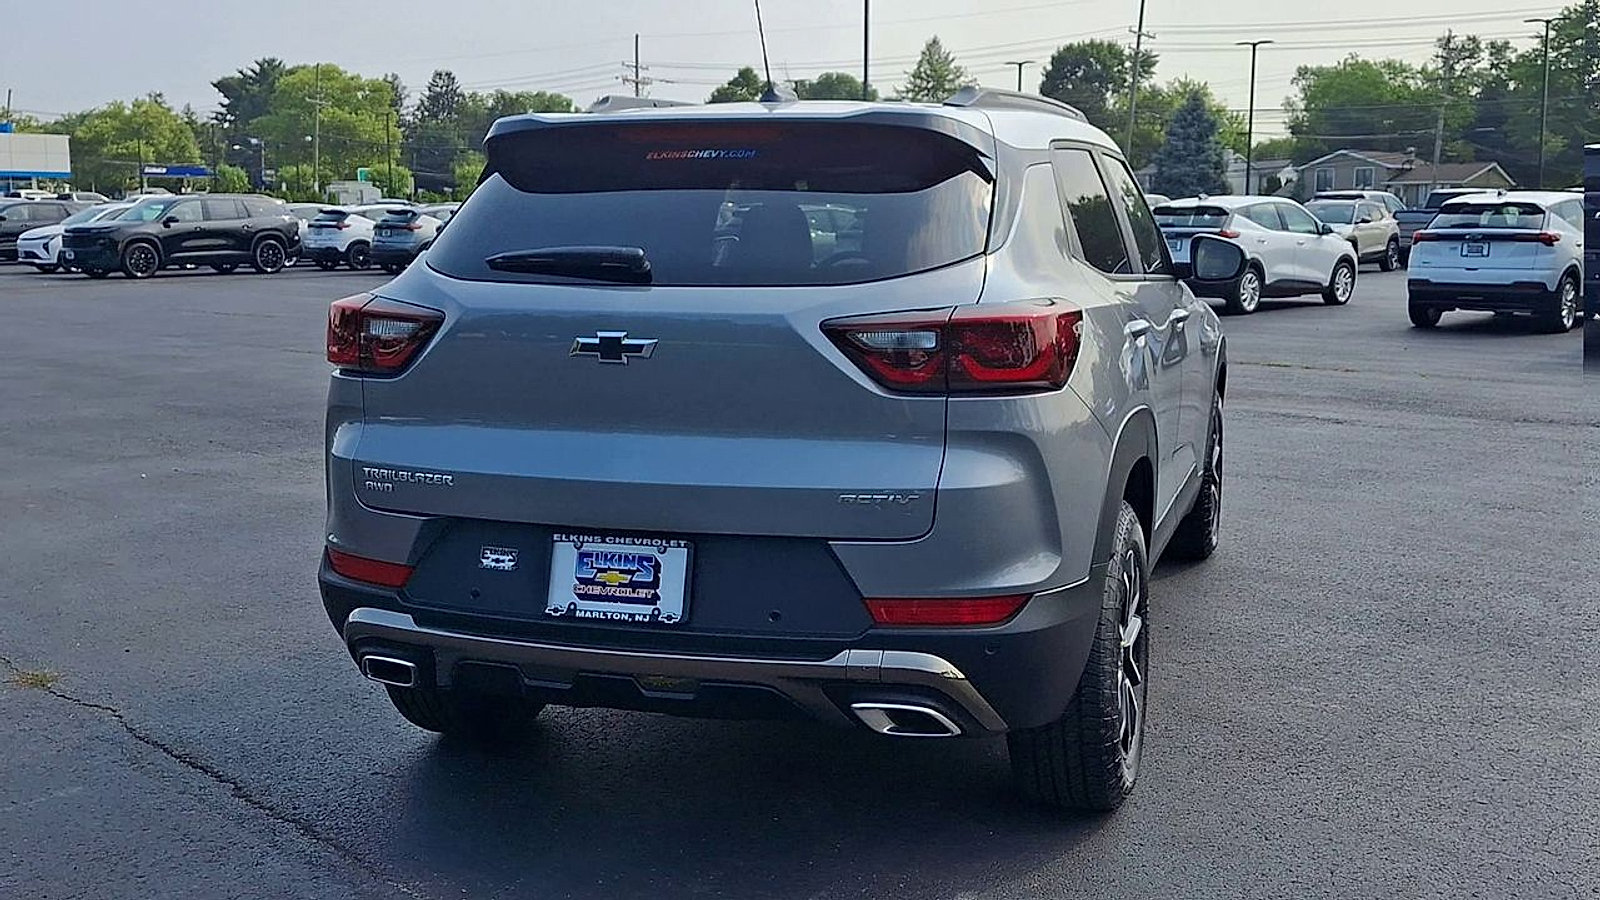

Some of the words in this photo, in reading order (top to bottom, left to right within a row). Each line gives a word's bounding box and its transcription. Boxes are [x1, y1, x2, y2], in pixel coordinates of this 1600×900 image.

[646, 149, 757, 160] ELKINSCHEVY.COM
[362, 467, 454, 487] TRAILBLAZER
[365, 481, 393, 493] AWD
[553, 533, 602, 544] ELKINS
[605, 535, 688, 548] CHEVROLET
[576, 551, 656, 582] ELKINS
[573, 584, 655, 599] CHEVROLET
[575, 609, 632, 622] MARLTON,
[635, 613, 650, 622] NJ
